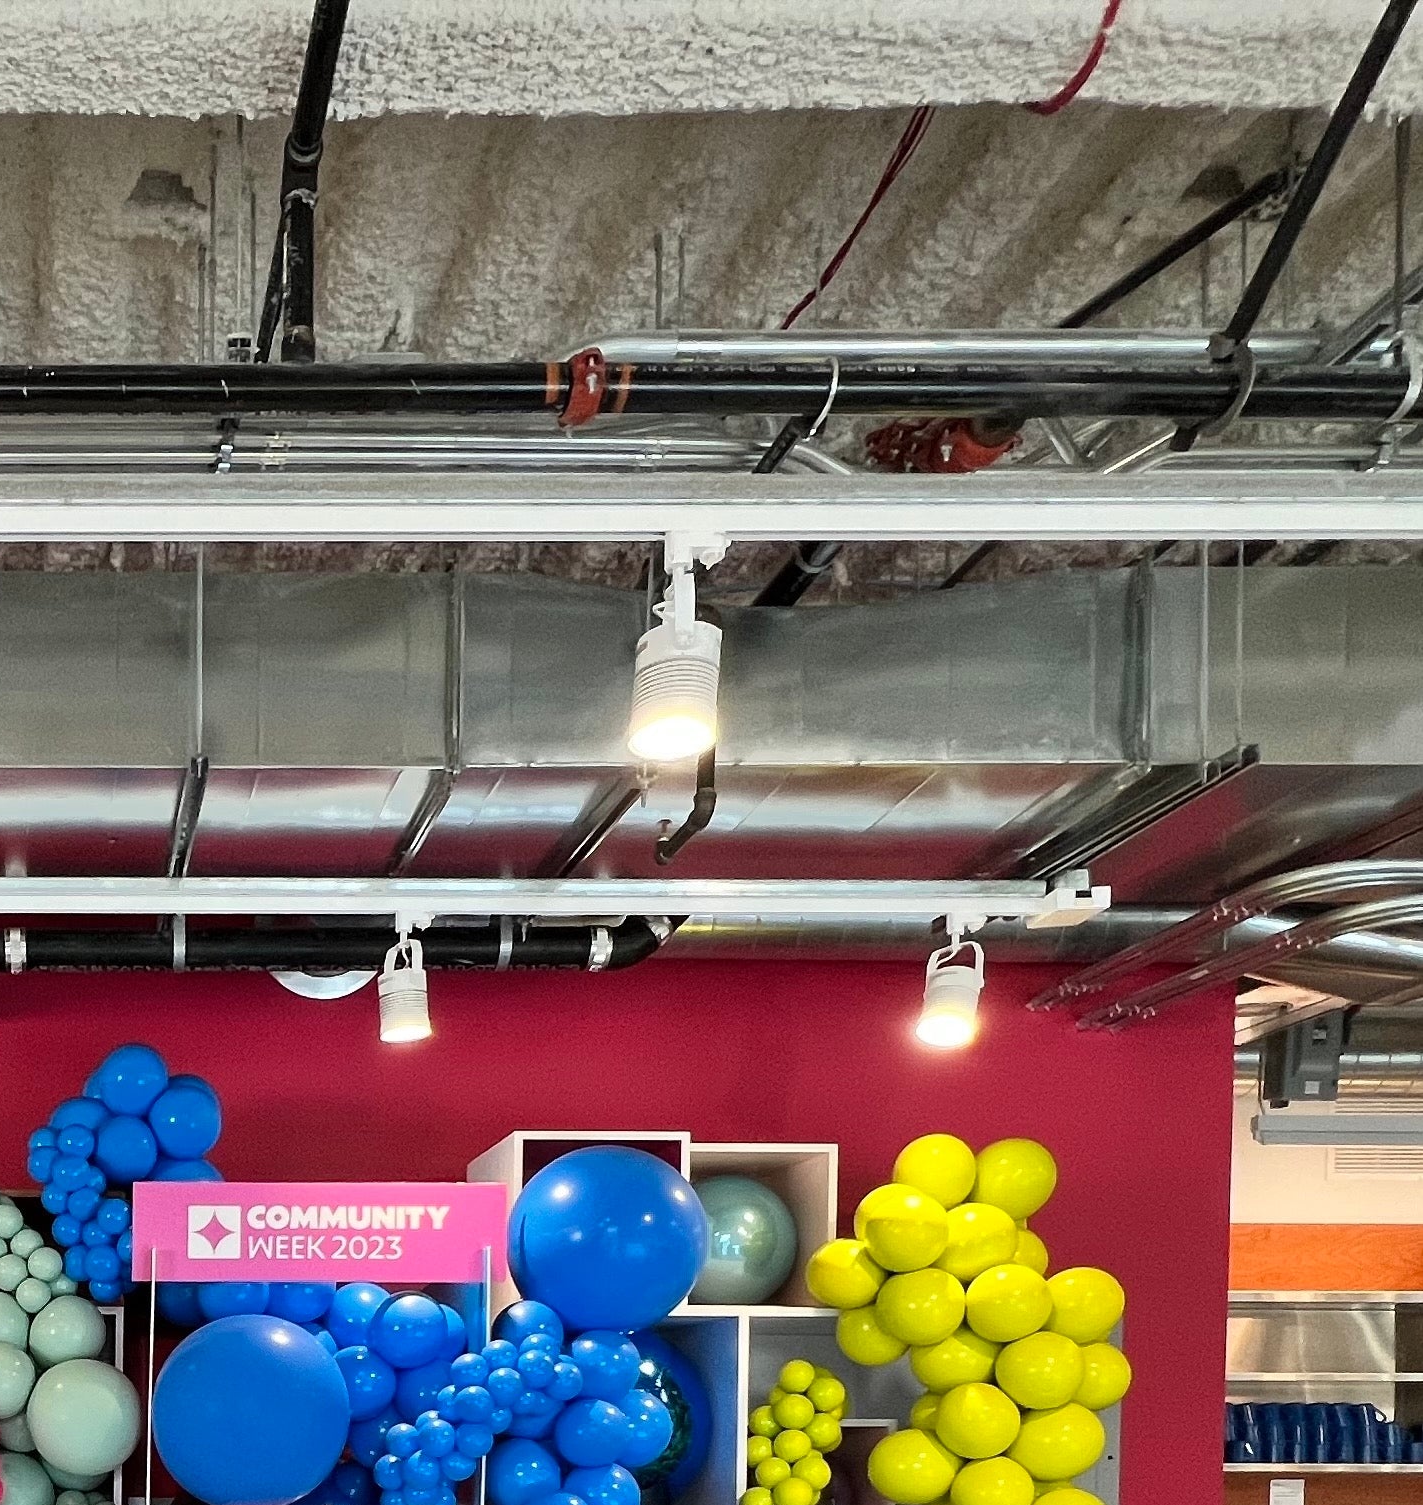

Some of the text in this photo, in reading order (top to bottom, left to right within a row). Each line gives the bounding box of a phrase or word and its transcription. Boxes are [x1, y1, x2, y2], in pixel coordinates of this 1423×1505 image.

[246, 1204, 451, 1230] COMMUNITY
[247, 1235, 403, 1260] WEEK 2023
